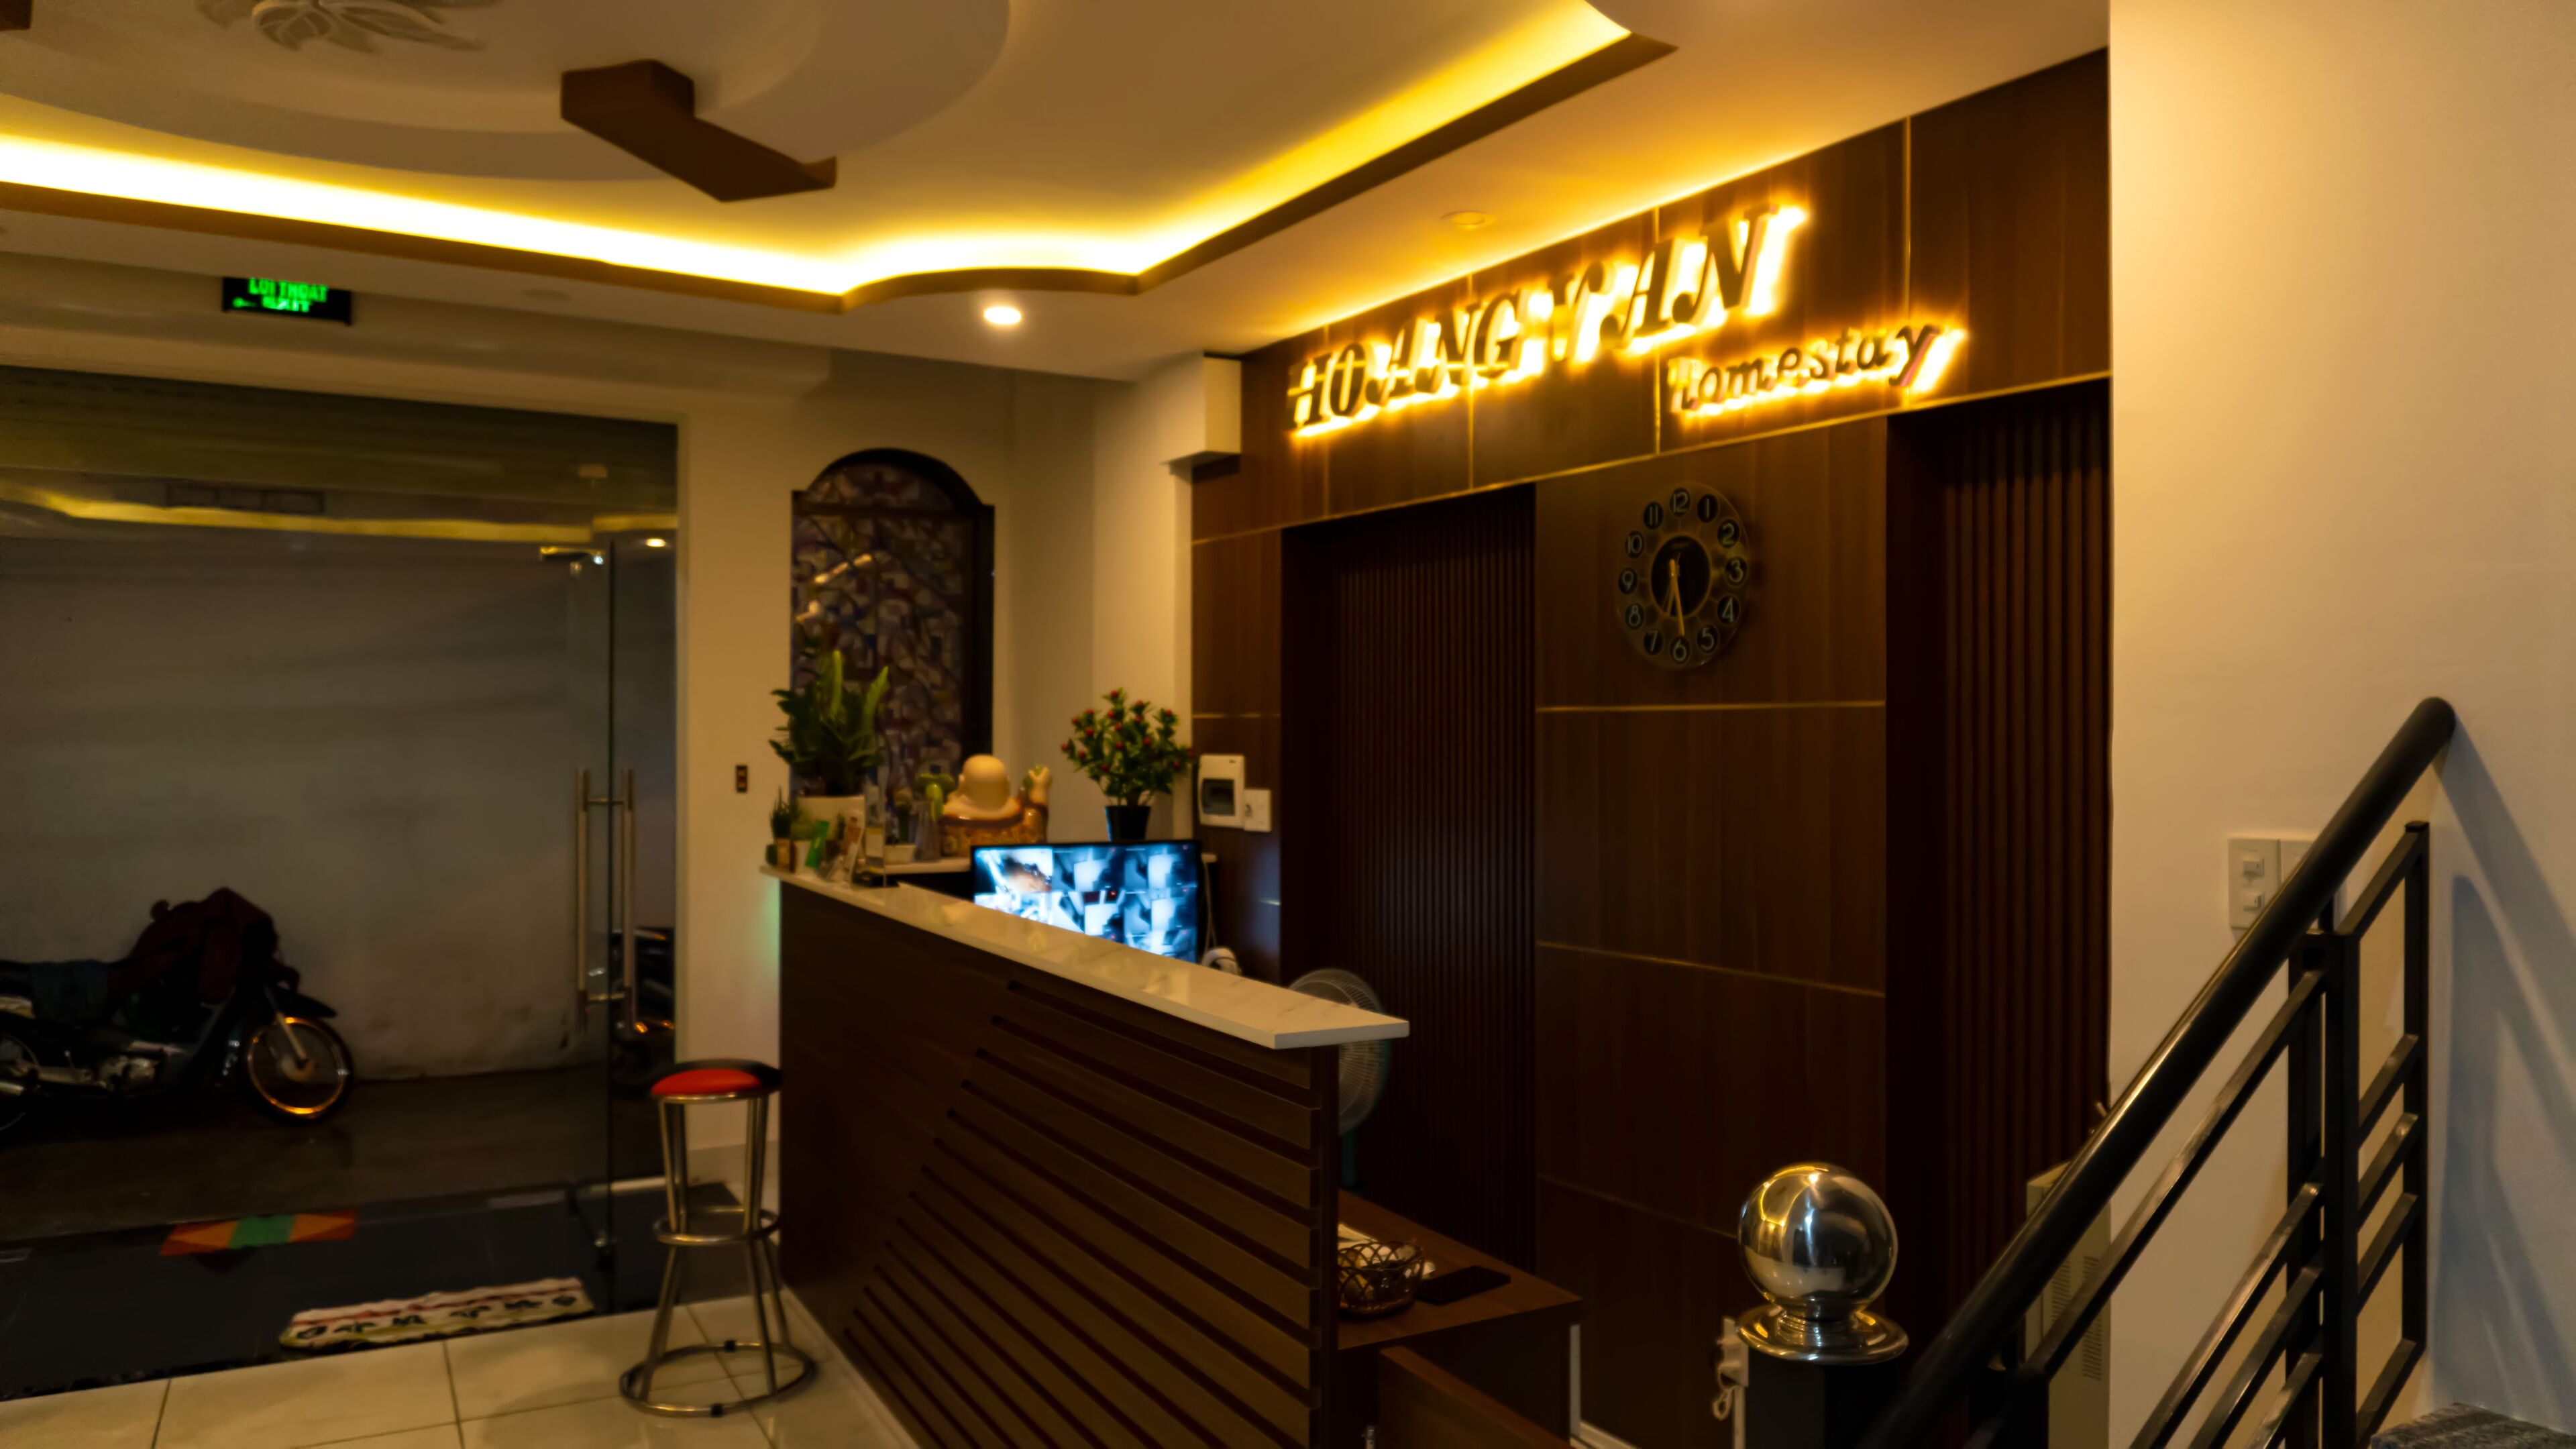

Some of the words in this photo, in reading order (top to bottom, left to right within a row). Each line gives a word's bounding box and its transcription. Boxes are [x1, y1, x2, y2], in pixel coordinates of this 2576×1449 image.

[1669, 324, 1942, 411] homestay
[1672, 491, 1688, 514] 12
[1705, 498, 1711, 519] 1
[1649, 505, 1659, 526] 11
[1627, 534, 1643, 555] 10
[1722, 522, 1735, 545] 2
[1621, 570, 1634, 592] 9
[1729, 559, 1744, 583] 3
[1628, 604, 1642, 627] 8
[1721, 597, 1735, 623] 4
[1648, 630, 1659, 653] 7
[1672, 638, 1687, 661] 6
[1701, 627, 1715, 651] 5
